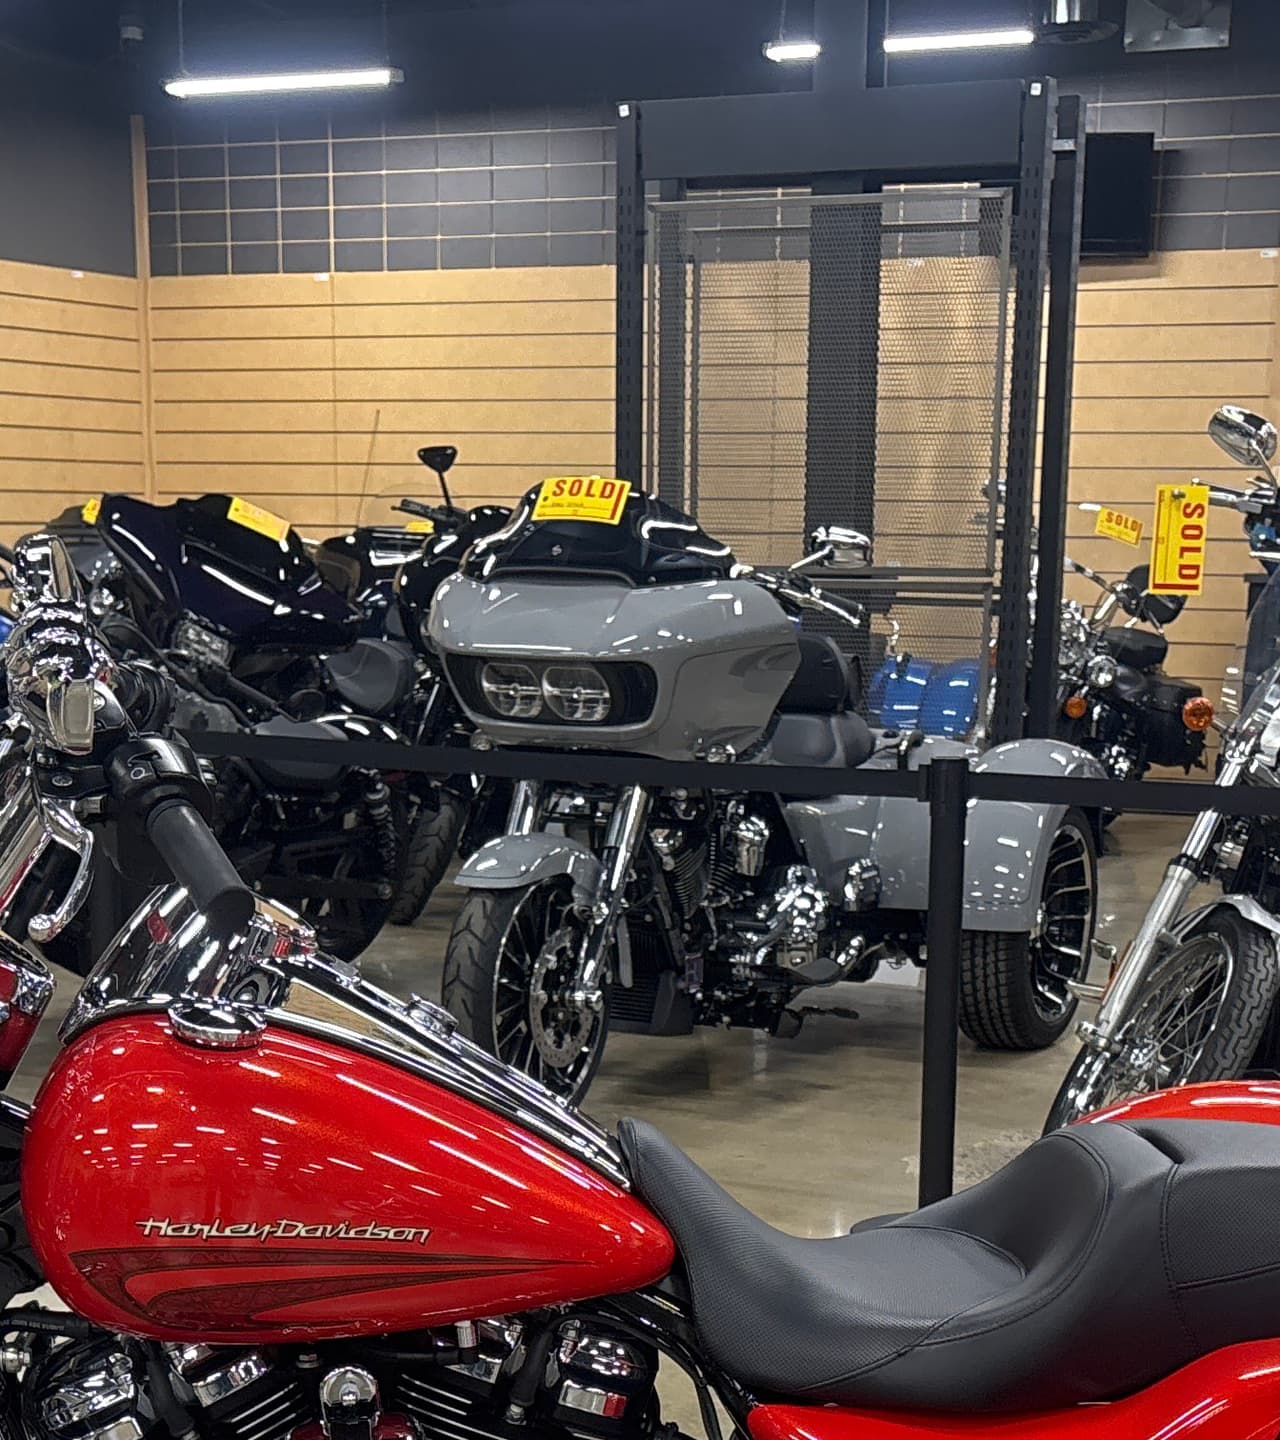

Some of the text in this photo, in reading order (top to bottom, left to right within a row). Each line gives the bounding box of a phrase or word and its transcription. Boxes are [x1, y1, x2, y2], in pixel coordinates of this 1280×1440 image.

[552, 479, 616, 499] SOLD
[1105, 511, 1139, 533] SOLD
[1178, 502, 1205, 580] SOLD
[135, 1217, 431, 1243] Harley-Davidson
